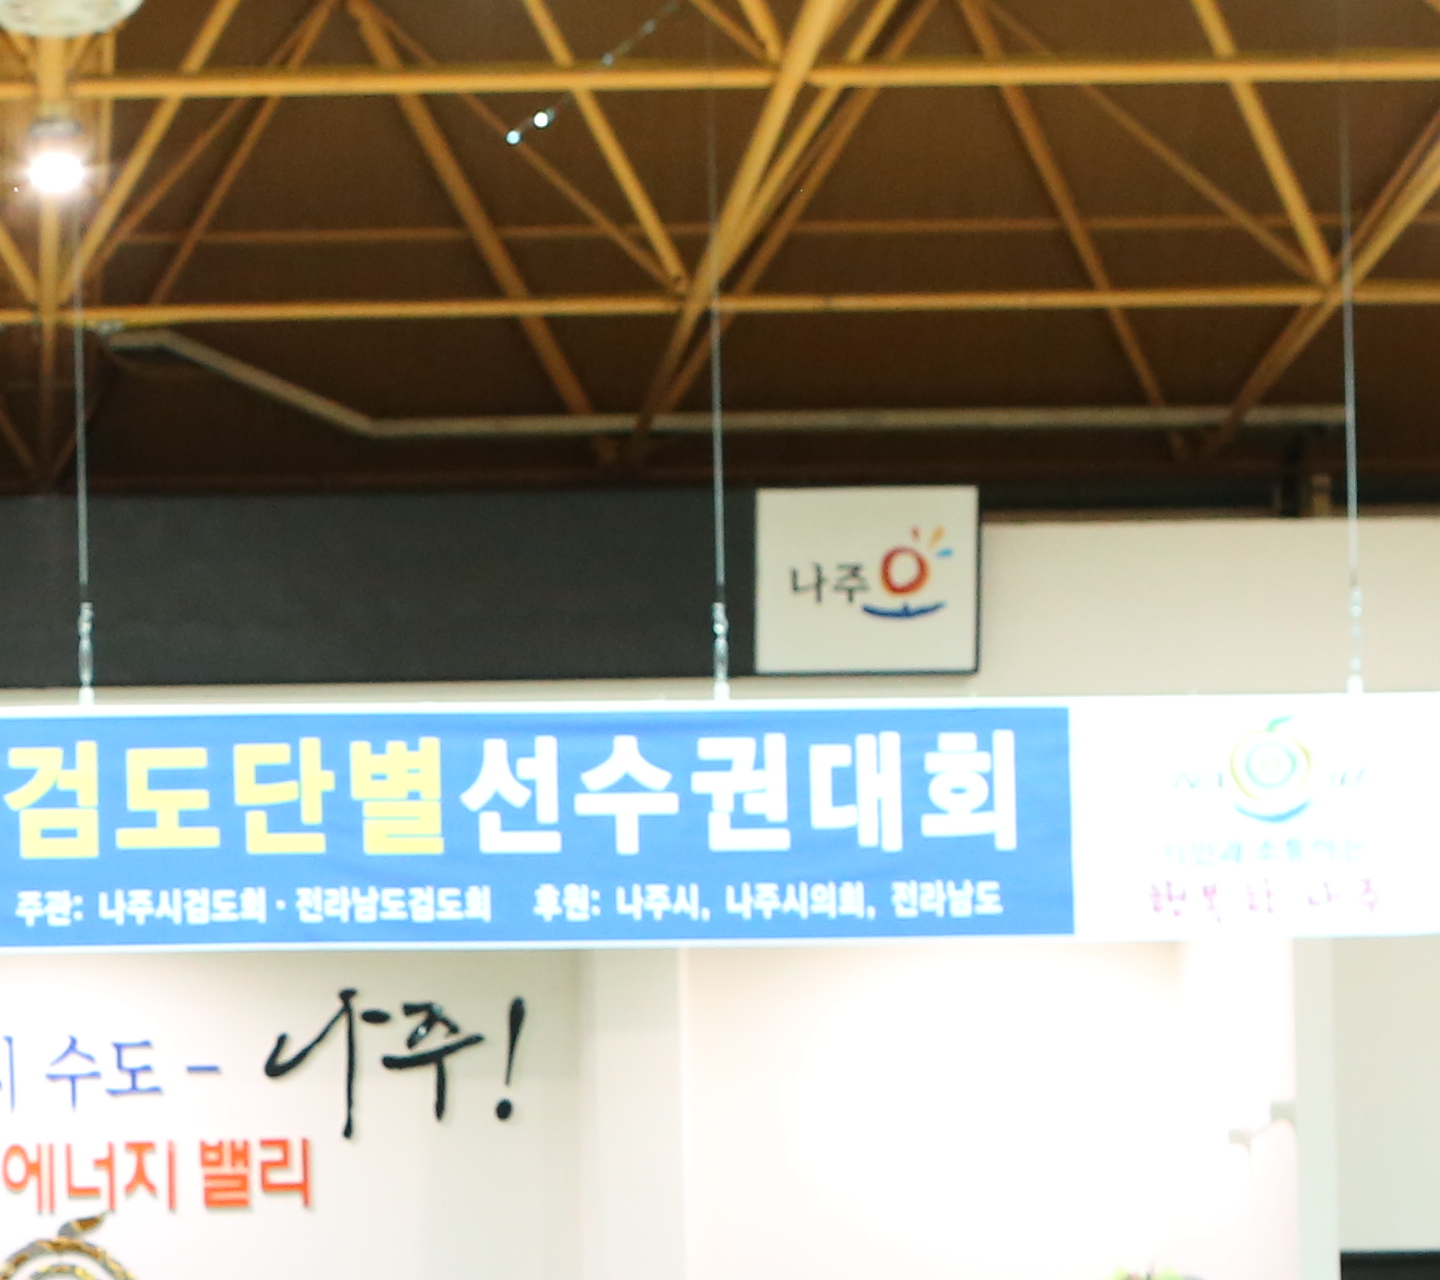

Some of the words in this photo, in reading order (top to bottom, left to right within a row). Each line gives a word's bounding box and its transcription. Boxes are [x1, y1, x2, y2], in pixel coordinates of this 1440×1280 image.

[44, 1034, 165, 1112] 수도
[2, 1139, 178, 1214] 에너지
[200, 1136, 312, 1210] 밸리
